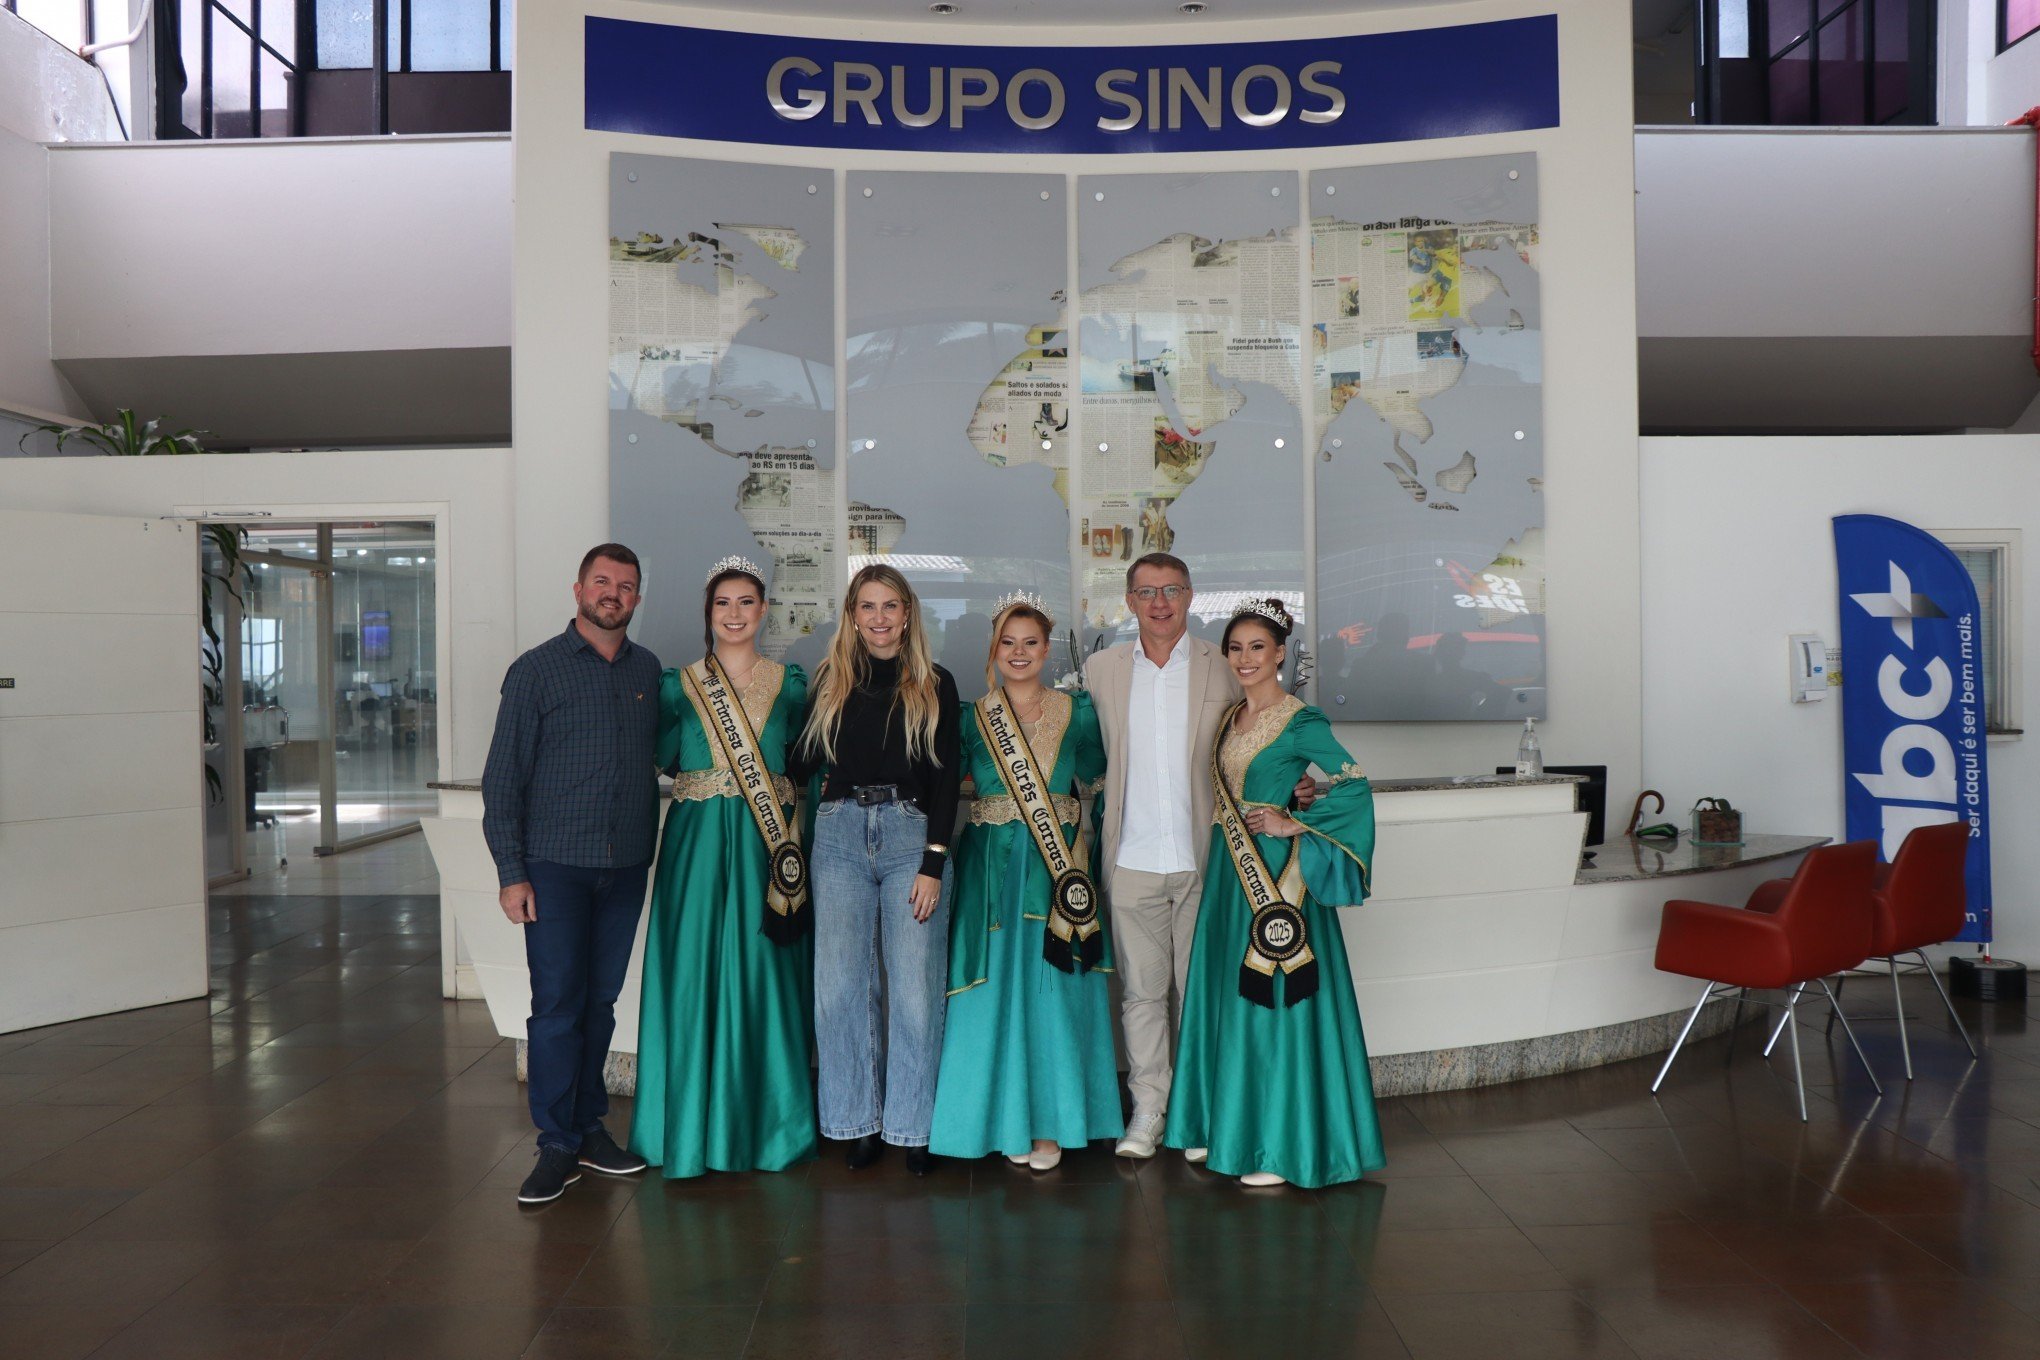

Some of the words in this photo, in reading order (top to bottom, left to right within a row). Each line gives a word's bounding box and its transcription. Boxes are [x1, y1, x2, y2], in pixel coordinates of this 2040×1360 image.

[766, 56, 1066, 131] GRUPO
[1095, 60, 1346, 133] SINOS
[1400, 217, 1430, 229] larga
[1007, 381, 1028, 389] Saltos
[1035, 381, 1061, 389] solados
[754, 452, 772, 460] deve
[763, 461, 773, 469] RS
[774, 462, 786, 470] em
[788, 461, 798, 470] 15
[799, 461, 815, 471] dias
[865, 513, 883, 521] para
[768, 530, 791, 538] soluções
[1956, 612, 1973, 660] mais.
[1959, 663, 1976, 704] bem
[1962, 706, 1977, 735] ser
[1958, 738, 1977, 750] é
[708, 687, 745, 751] Princesa
[737, 751, 761, 789] Três
[753, 791, 782, 843] Coroas
[986, 703, 1017, 757] Rainha
[1011, 757, 1038, 804] Três
[1032, 807, 1068, 873] Coroas
[1962, 752, 1981, 806] daqui
[1968, 808, 1980, 838] Ser
[785, 859, 798, 878] 2025
[1226, 812, 1245, 851] Três
[1239, 852, 1270, 906] Coroas
[1070, 887, 1088, 907] 2025
[1268, 922, 1291, 943] 2025
